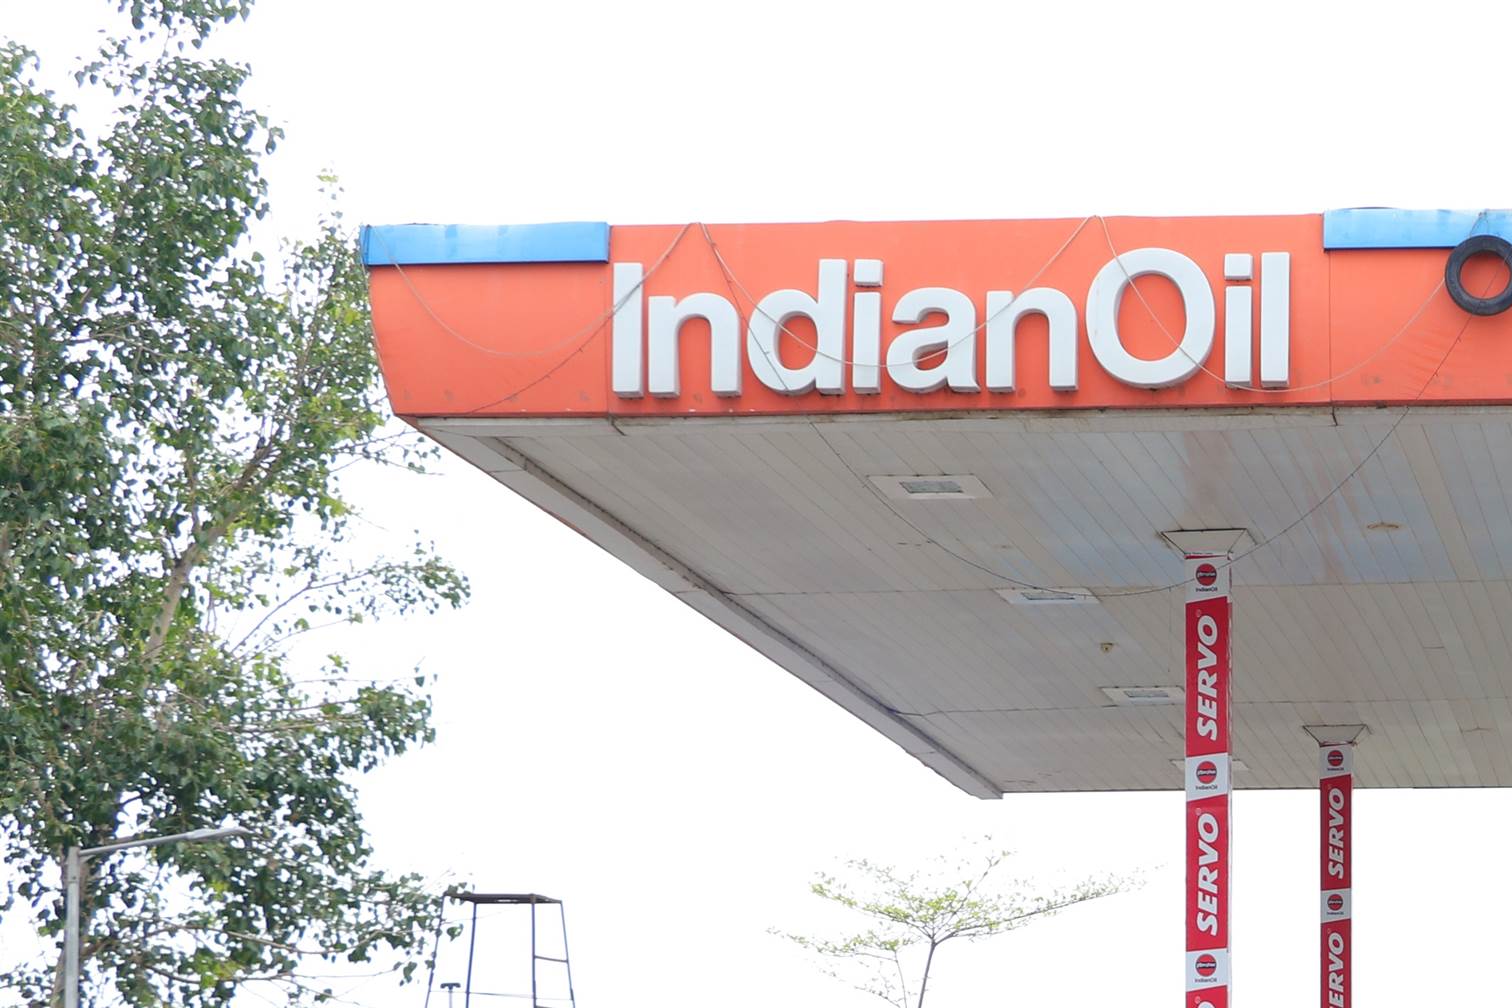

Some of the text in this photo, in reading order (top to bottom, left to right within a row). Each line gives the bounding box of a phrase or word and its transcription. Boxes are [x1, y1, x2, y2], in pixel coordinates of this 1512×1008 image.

[612, 247, 1292, 398] IndianOil
[1197, 614, 1218, 741] SERVO
[1197, 811, 1219, 936] SERVO
[1328, 787, 1345, 880] SERVO
